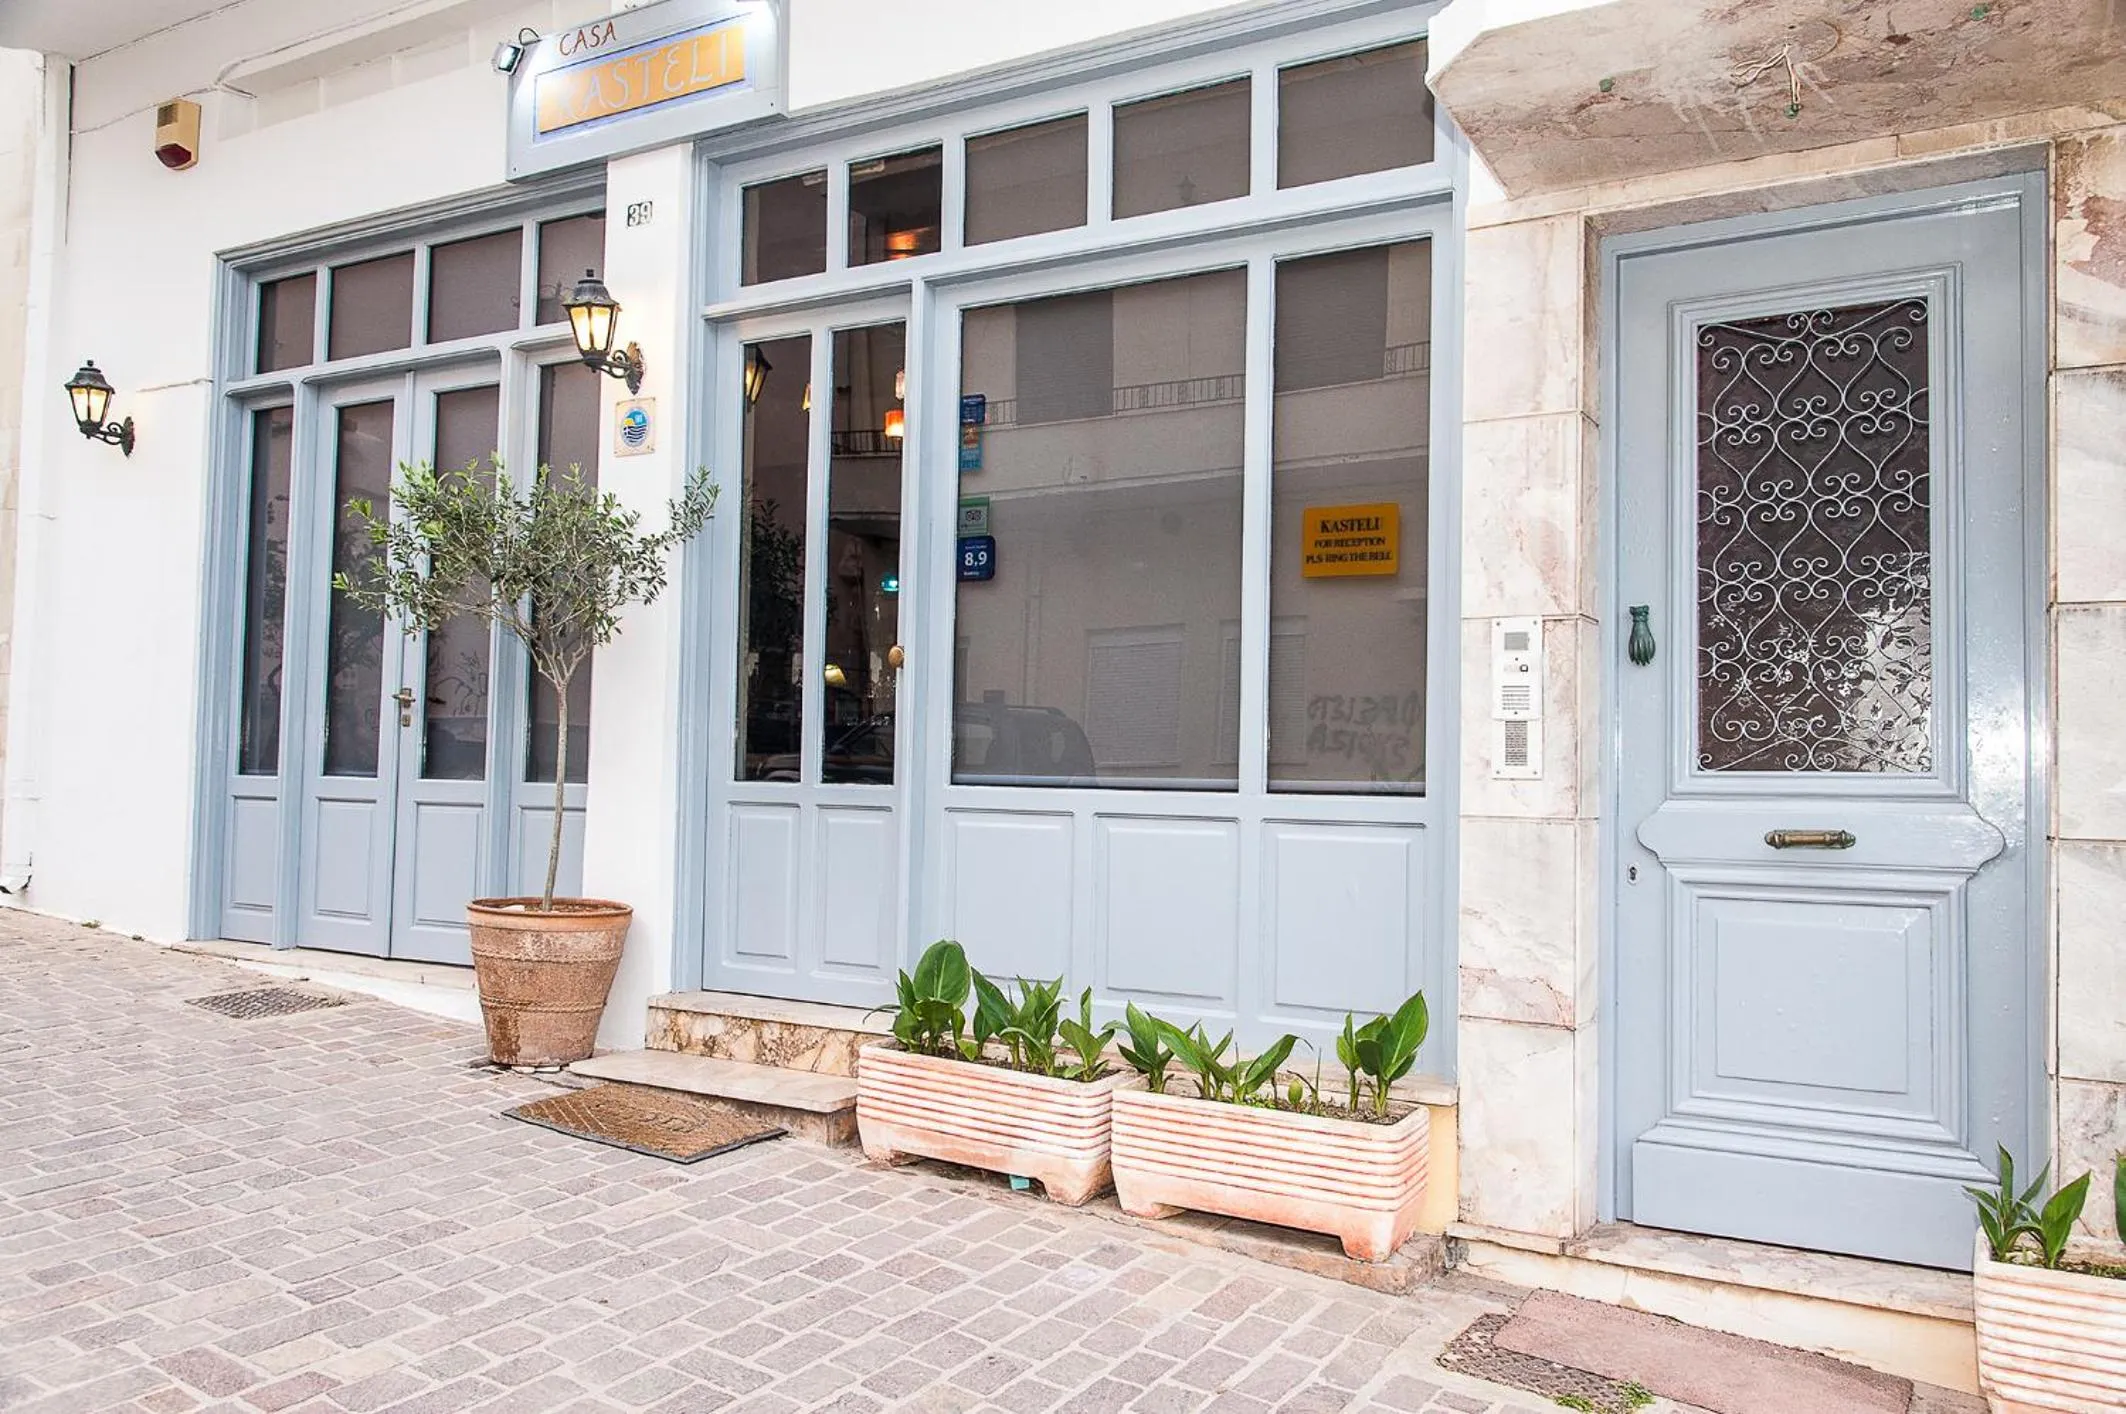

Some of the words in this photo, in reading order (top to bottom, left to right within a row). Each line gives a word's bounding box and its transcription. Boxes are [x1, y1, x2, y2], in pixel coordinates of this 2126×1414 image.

[559, 20, 616, 56] CASA
[628, 201, 652, 226] 39
[1320, 517, 1379, 533] KASTELI
[965, 552, 987, 567] 8,9
